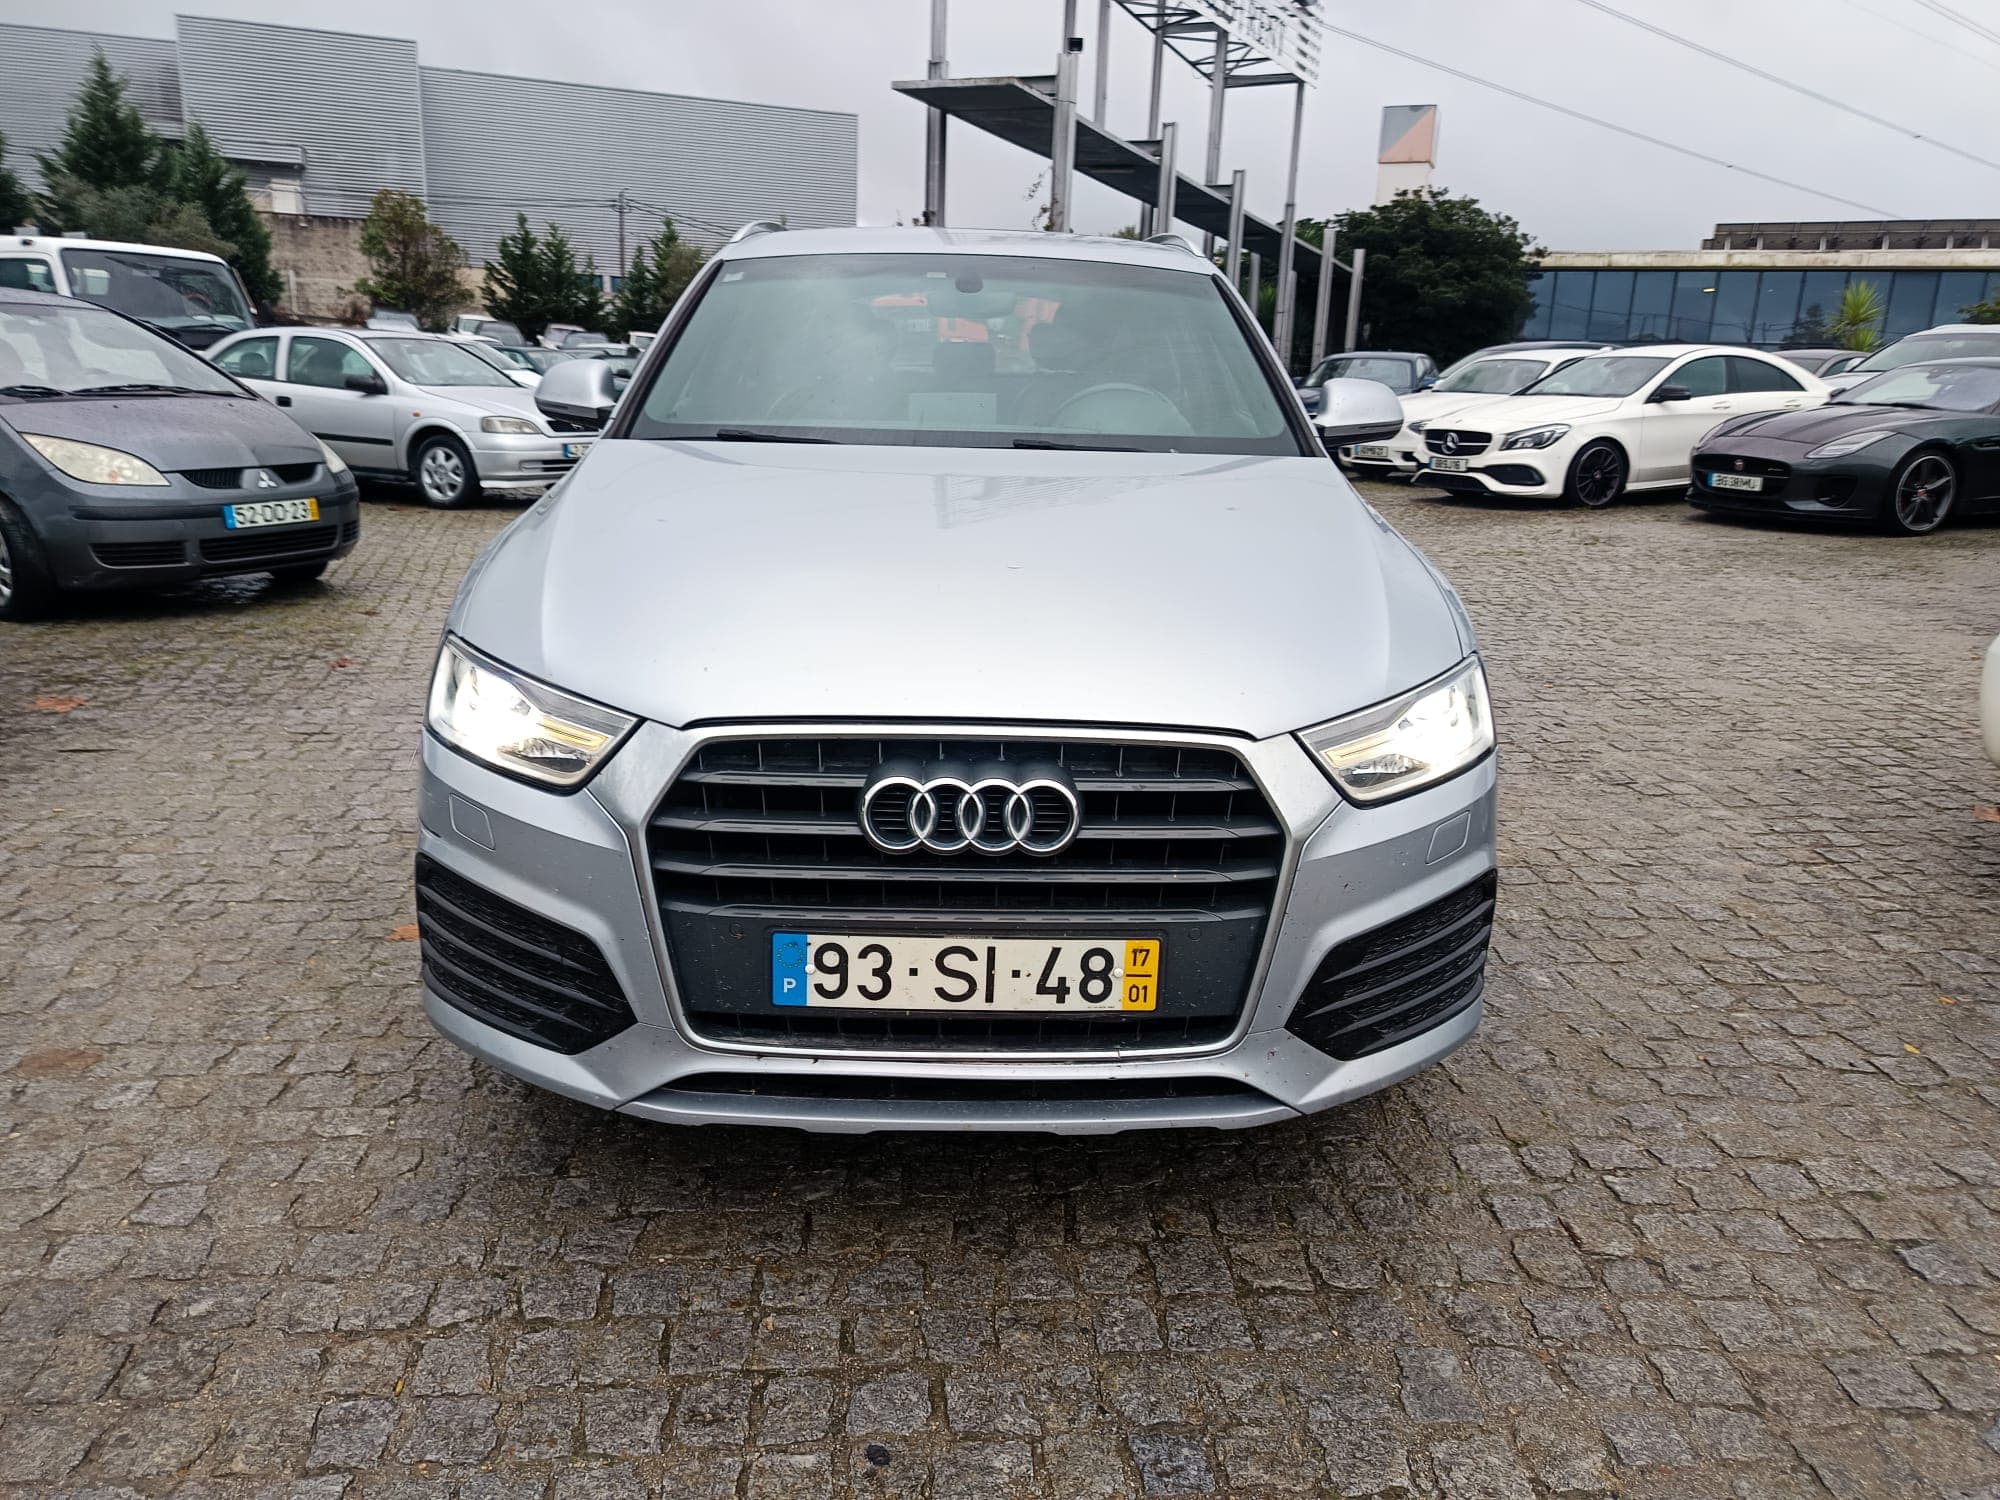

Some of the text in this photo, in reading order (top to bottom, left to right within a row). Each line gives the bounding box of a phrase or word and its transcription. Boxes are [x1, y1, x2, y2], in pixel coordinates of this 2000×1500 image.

[1131, 948, 1150, 967] 17
[783, 977, 797, 993] P
[1128, 984, 1148, 1003] 01
